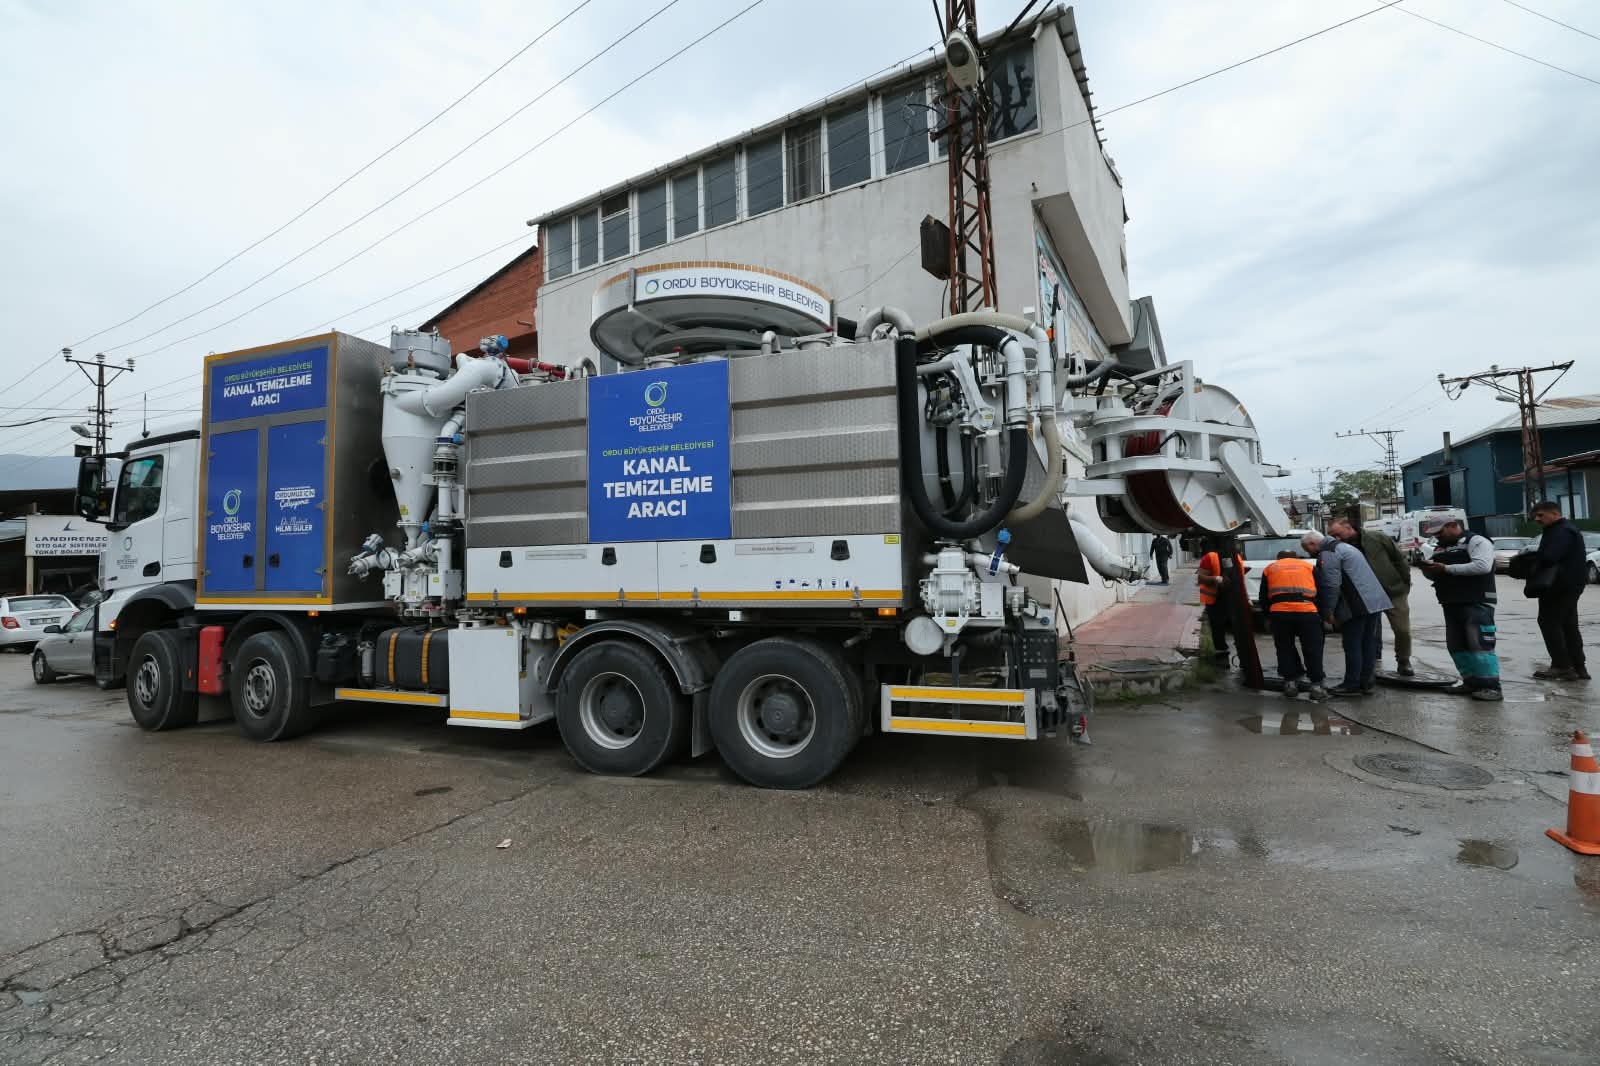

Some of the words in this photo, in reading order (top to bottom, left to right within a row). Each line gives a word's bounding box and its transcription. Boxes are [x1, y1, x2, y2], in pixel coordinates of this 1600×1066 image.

[663, 277, 697, 290] ORDU
[223, 383, 255, 398] KANAL
[250, 393, 280, 407] ARACI
[646, 407, 666, 416] ORDU
[602, 449, 623, 457] ORDU
[623, 455, 691, 476] KANAL
[627, 499, 687, 519] ARACI
